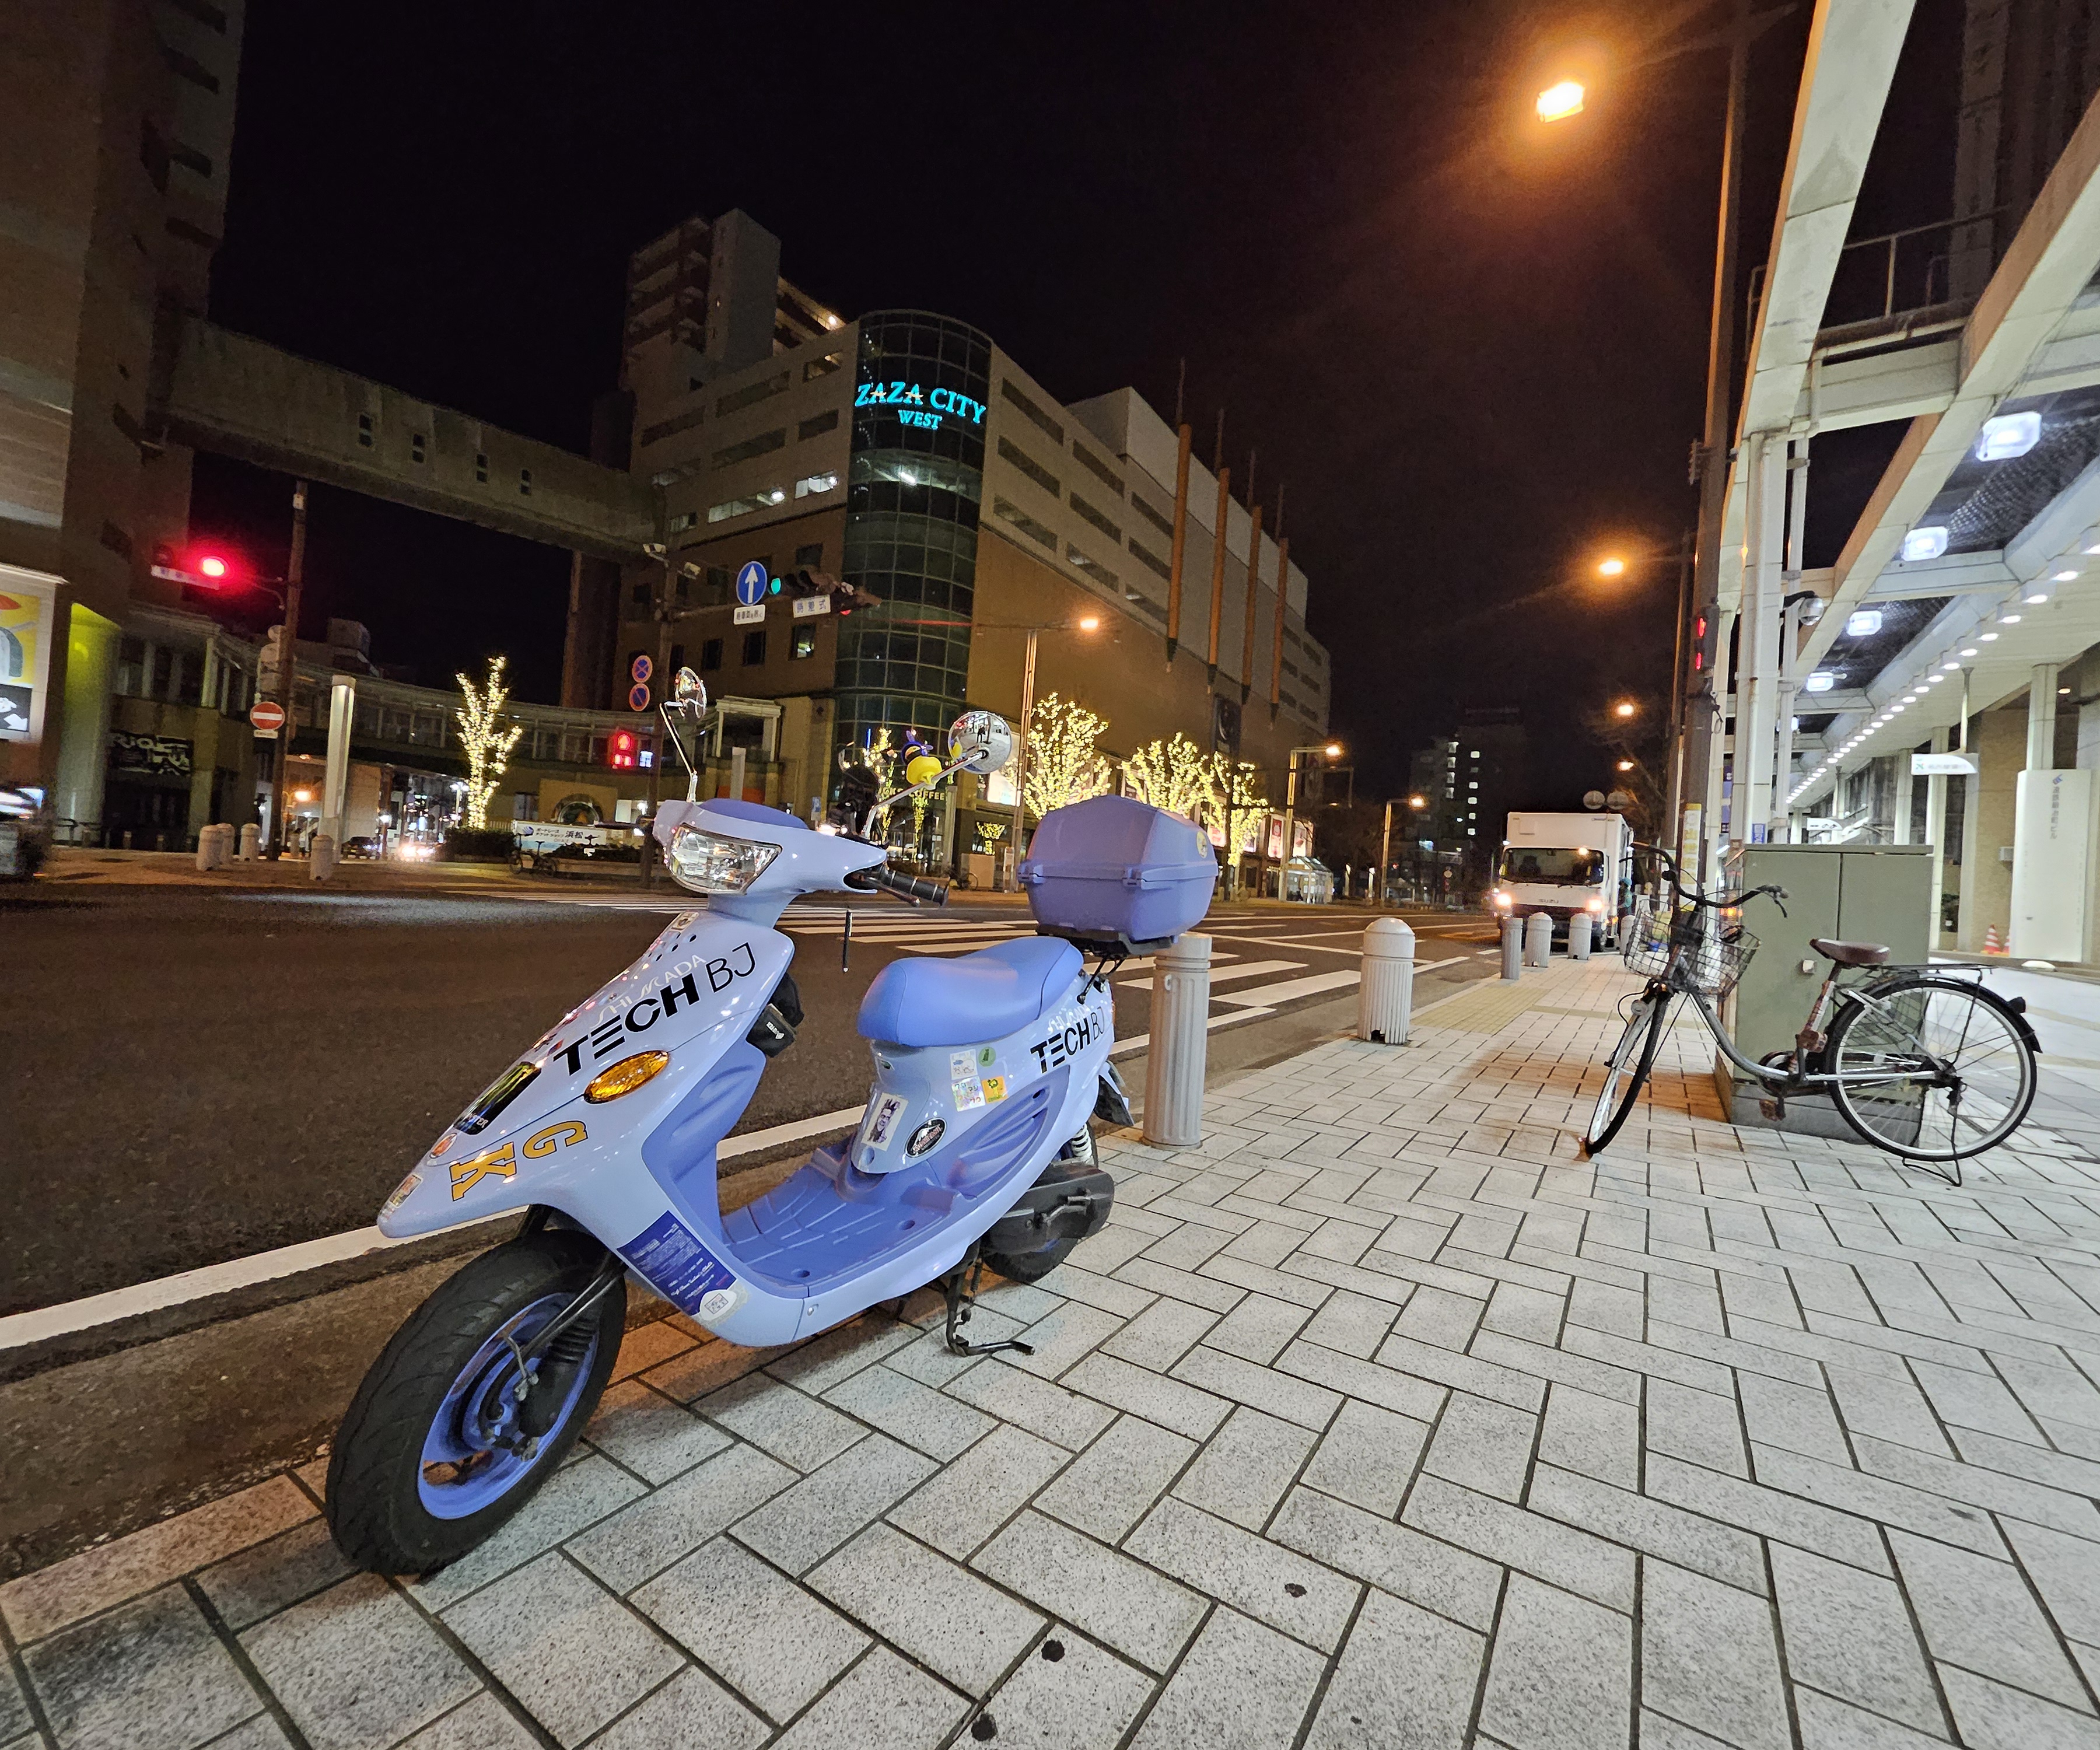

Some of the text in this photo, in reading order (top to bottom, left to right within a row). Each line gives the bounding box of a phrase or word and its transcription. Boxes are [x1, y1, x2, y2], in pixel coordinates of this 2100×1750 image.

[855, 381, 986, 424] ZAZA CITY
[897, 409, 943, 430] WEST
[553, 942, 757, 1076] TECH BJ
[1030, 1006, 1105, 1074] TECH BJ
